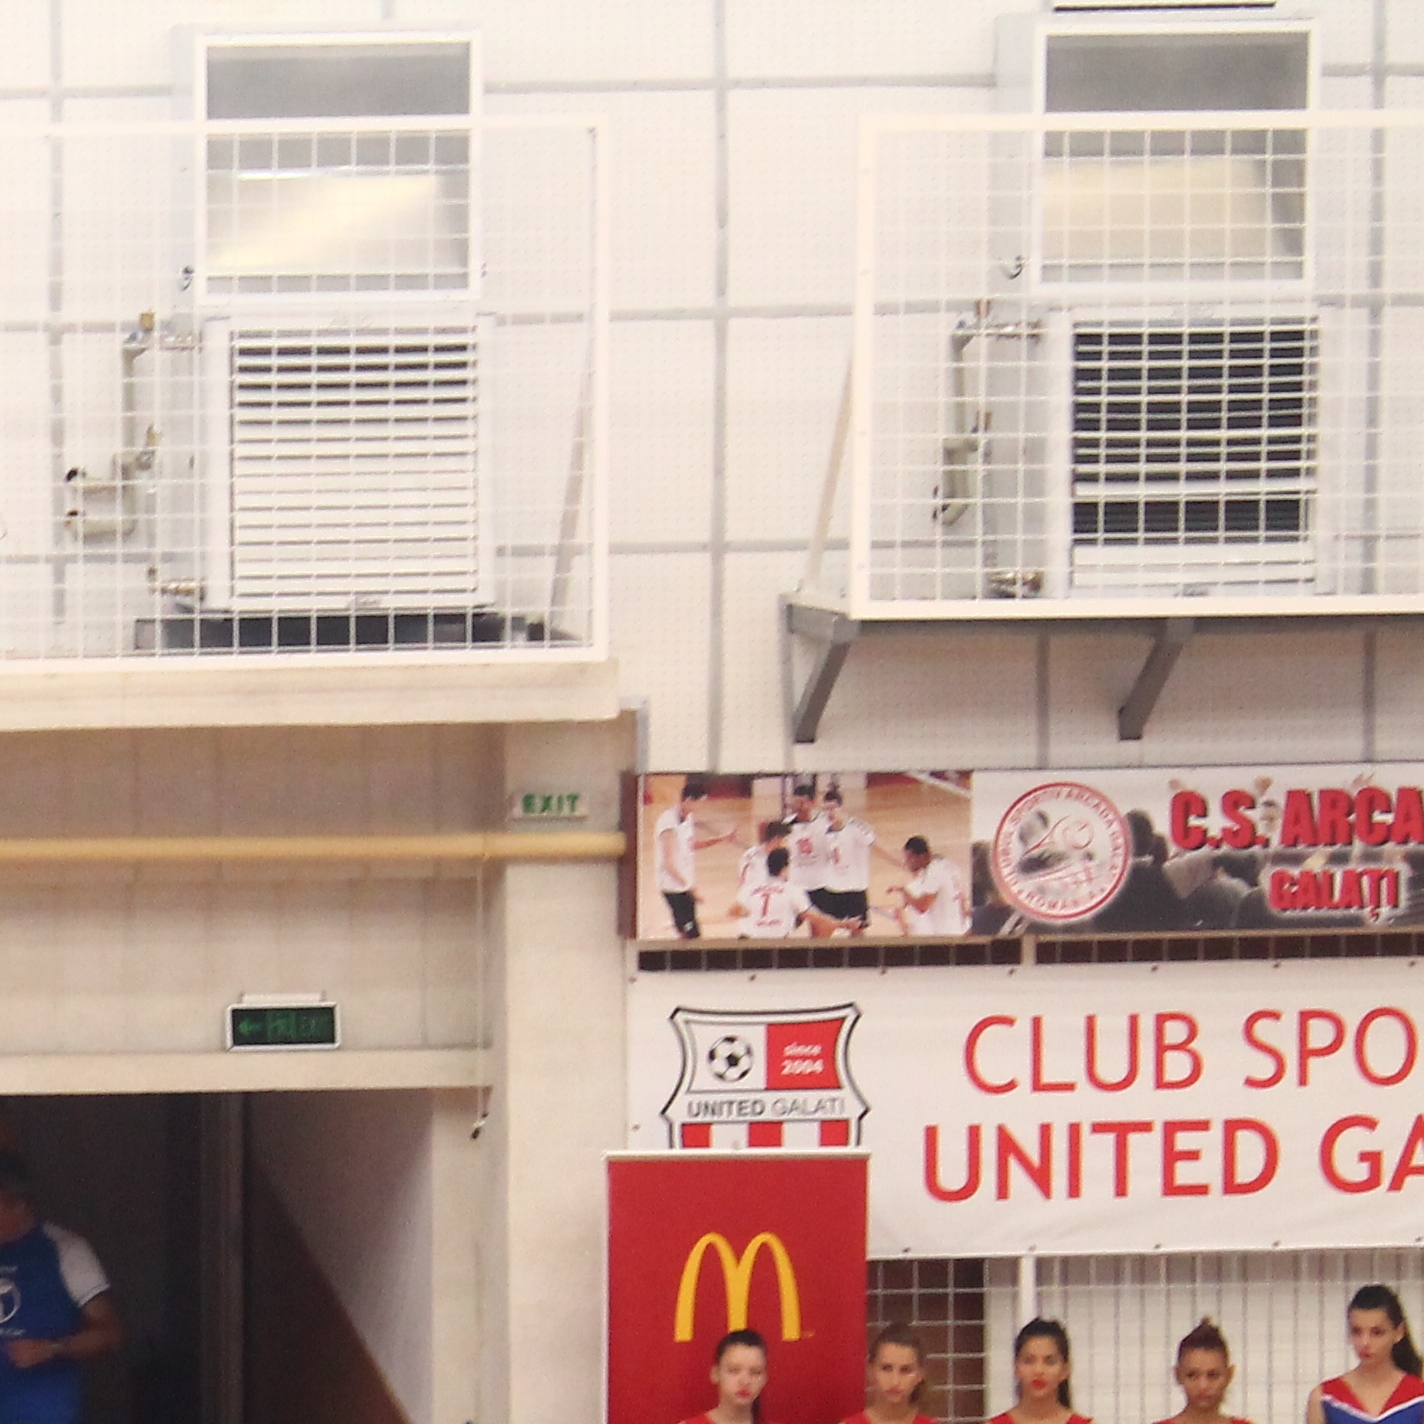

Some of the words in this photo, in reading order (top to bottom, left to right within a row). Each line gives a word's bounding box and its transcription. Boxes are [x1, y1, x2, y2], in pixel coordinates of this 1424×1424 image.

[523, 794, 580, 814] EXIT
[1171, 789, 1269, 849] C.S.
[1281, 786, 1424, 846] ARCA
[783, 1042, 822, 1057] since
[964, 1010, 1204, 1095] CLUB
[1243, 1006, 1419, 1089] SPO
[781, 1059, 824, 1075] 2004
[687, 1100, 766, 1118] UNITED
[770, 1099, 846, 1117] GALATI
[924, 1117, 1280, 1202] UNITED
